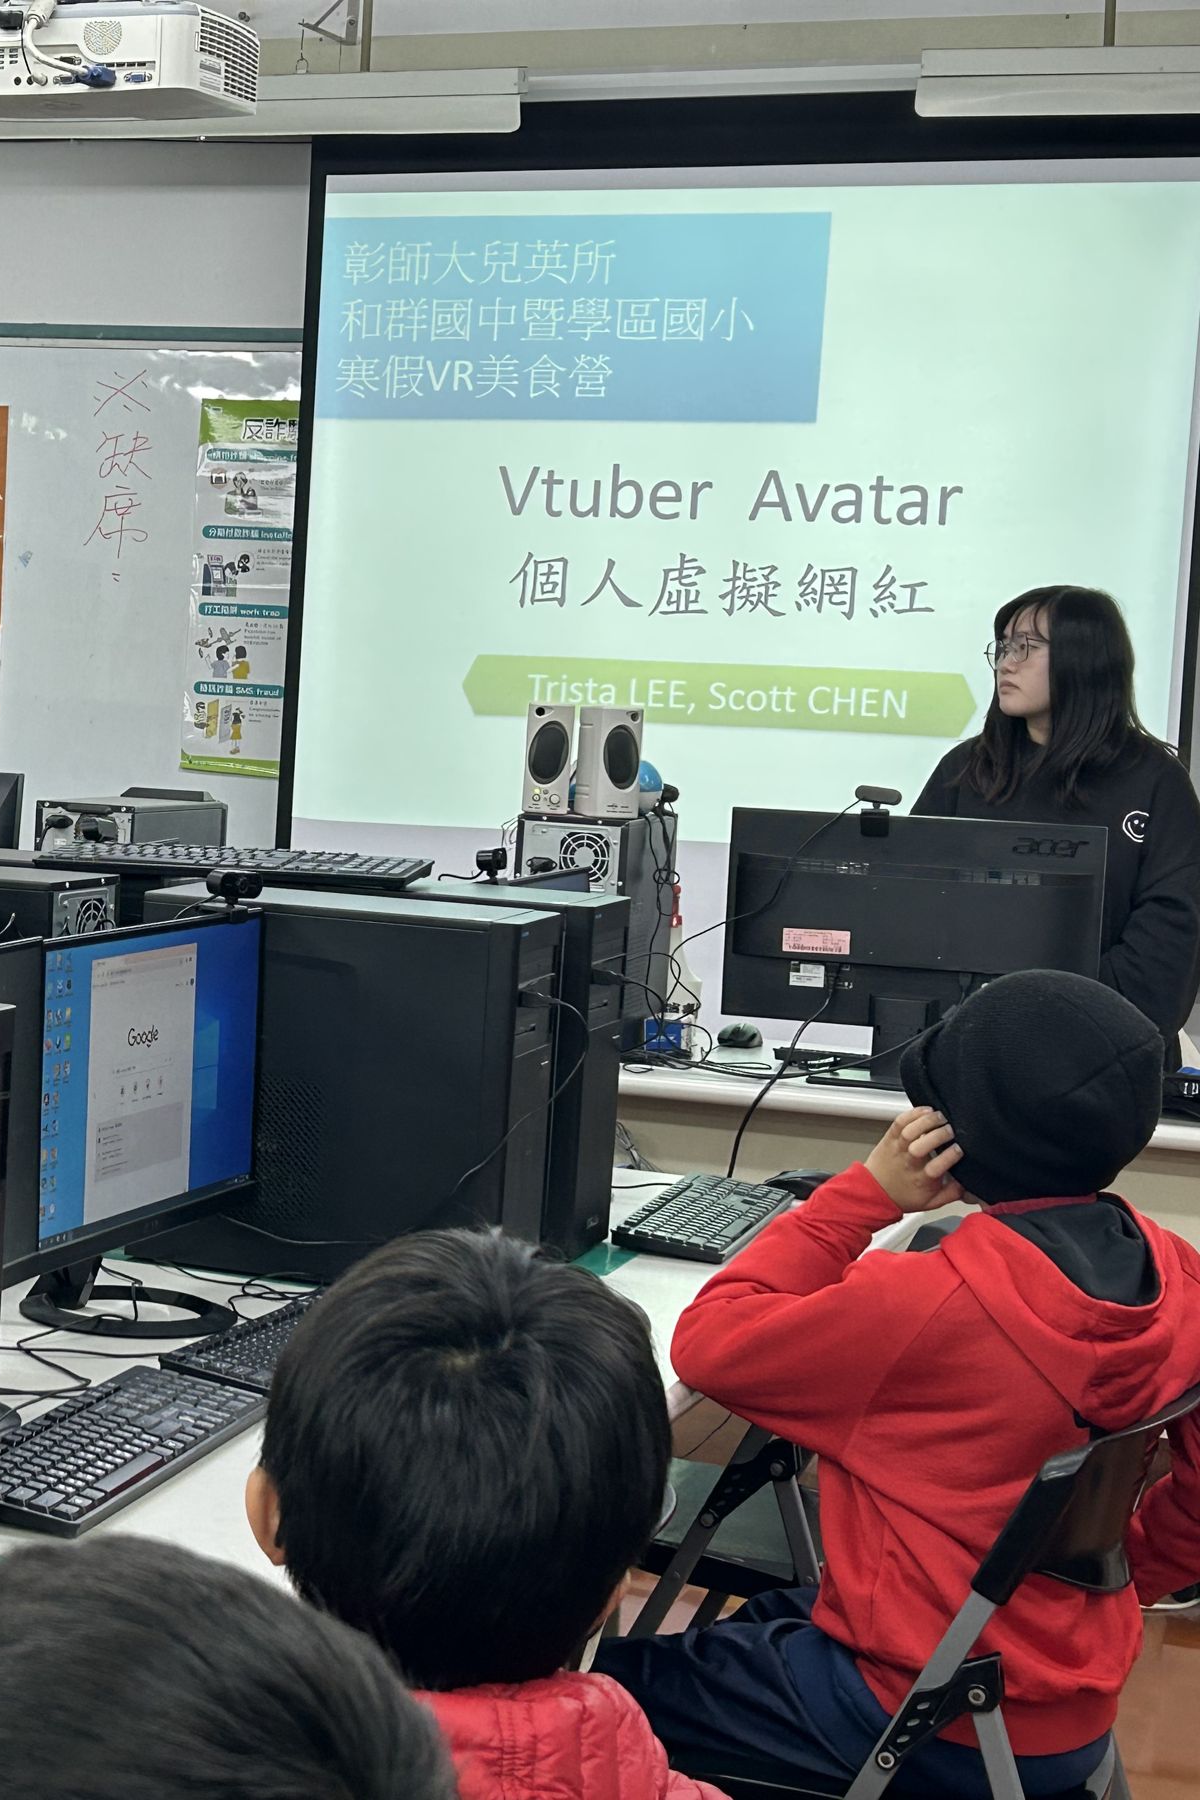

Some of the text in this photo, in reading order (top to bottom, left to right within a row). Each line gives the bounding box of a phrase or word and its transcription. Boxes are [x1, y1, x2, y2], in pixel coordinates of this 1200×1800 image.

[342, 240, 616, 285] 彰師大兒英所
[339, 297, 755, 342] 和群國中暨學區國小
[335, 354, 613, 399] 寒假VR美食營
[499, 463, 963, 526] Vtuber Avatar
[509, 551, 934, 621] 個人虛擬網紅
[528, 674, 908, 718] Trista LEE, Scott CHEN
[1012, 837, 1090, 858] acer
[128, 1025, 159, 1048] Google
